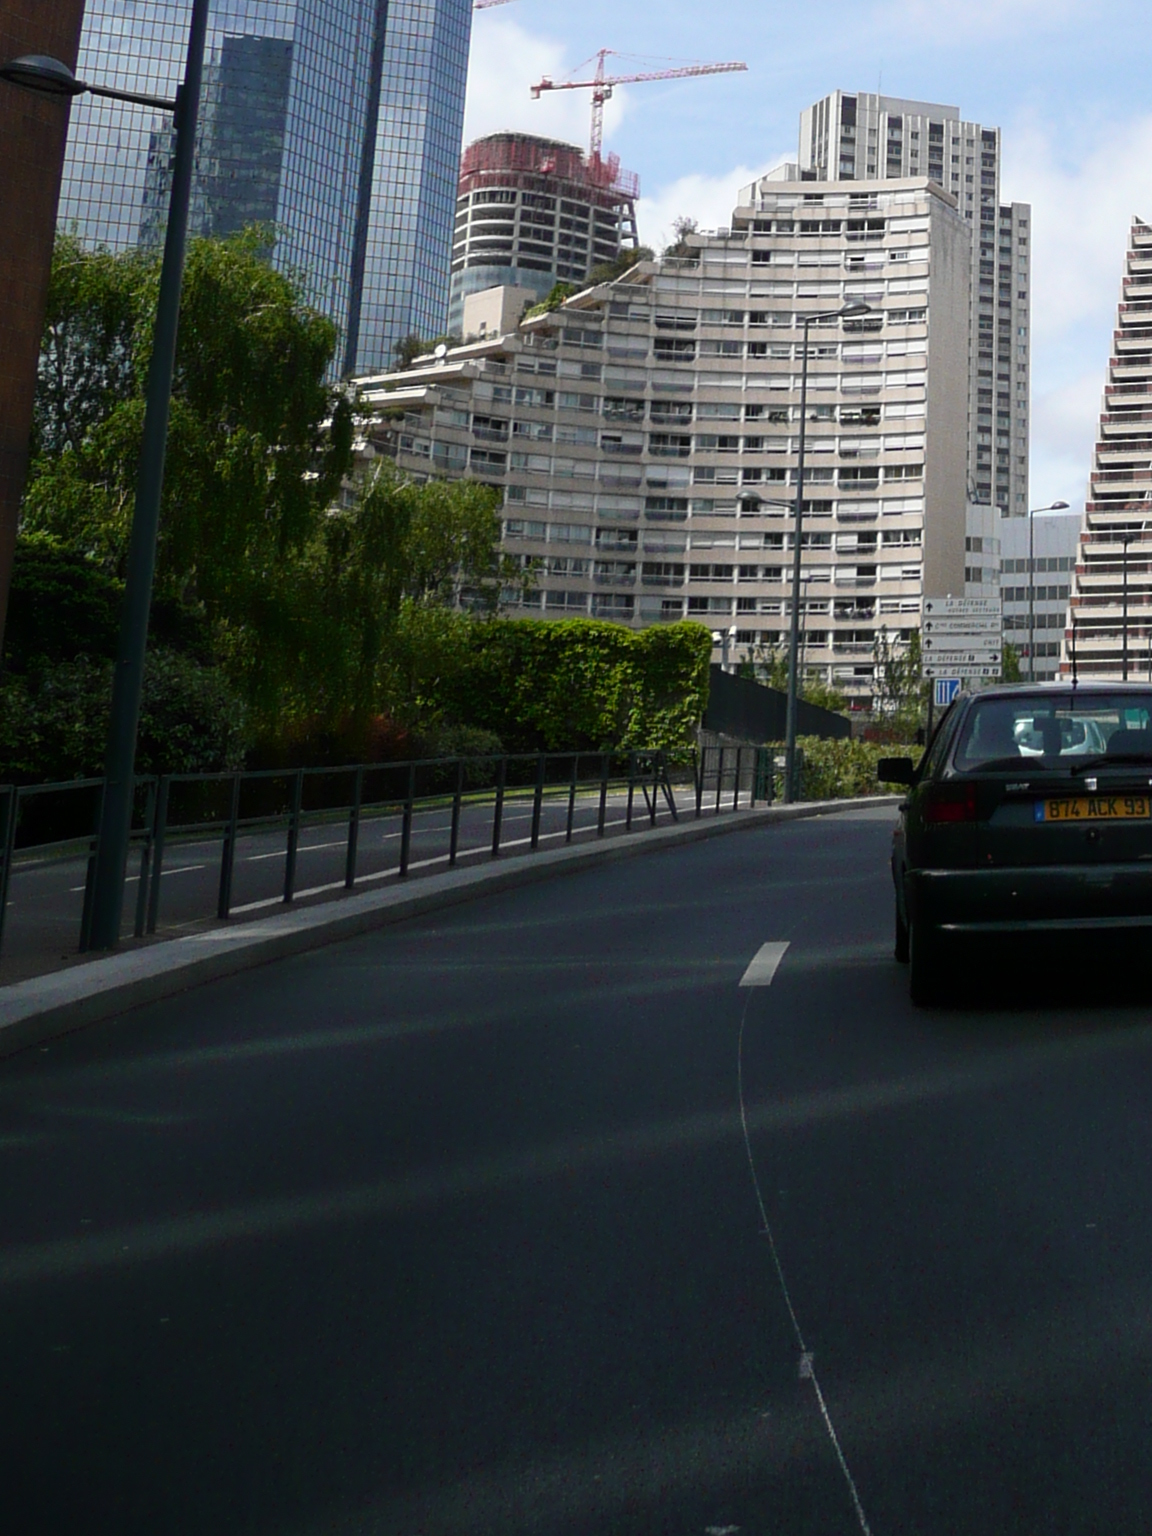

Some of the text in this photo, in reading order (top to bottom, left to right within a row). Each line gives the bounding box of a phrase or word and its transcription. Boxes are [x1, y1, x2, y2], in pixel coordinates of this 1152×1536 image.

[957, 598, 988, 607] DÉFENSE
[937, 653, 967, 662] DÉFENSE
[951, 666, 982, 675] DÉFENSE
[1048, 799, 1080, 818] 874
[1087, 798, 1118, 817] ACK
[1124, 798, 1146, 816] 93
